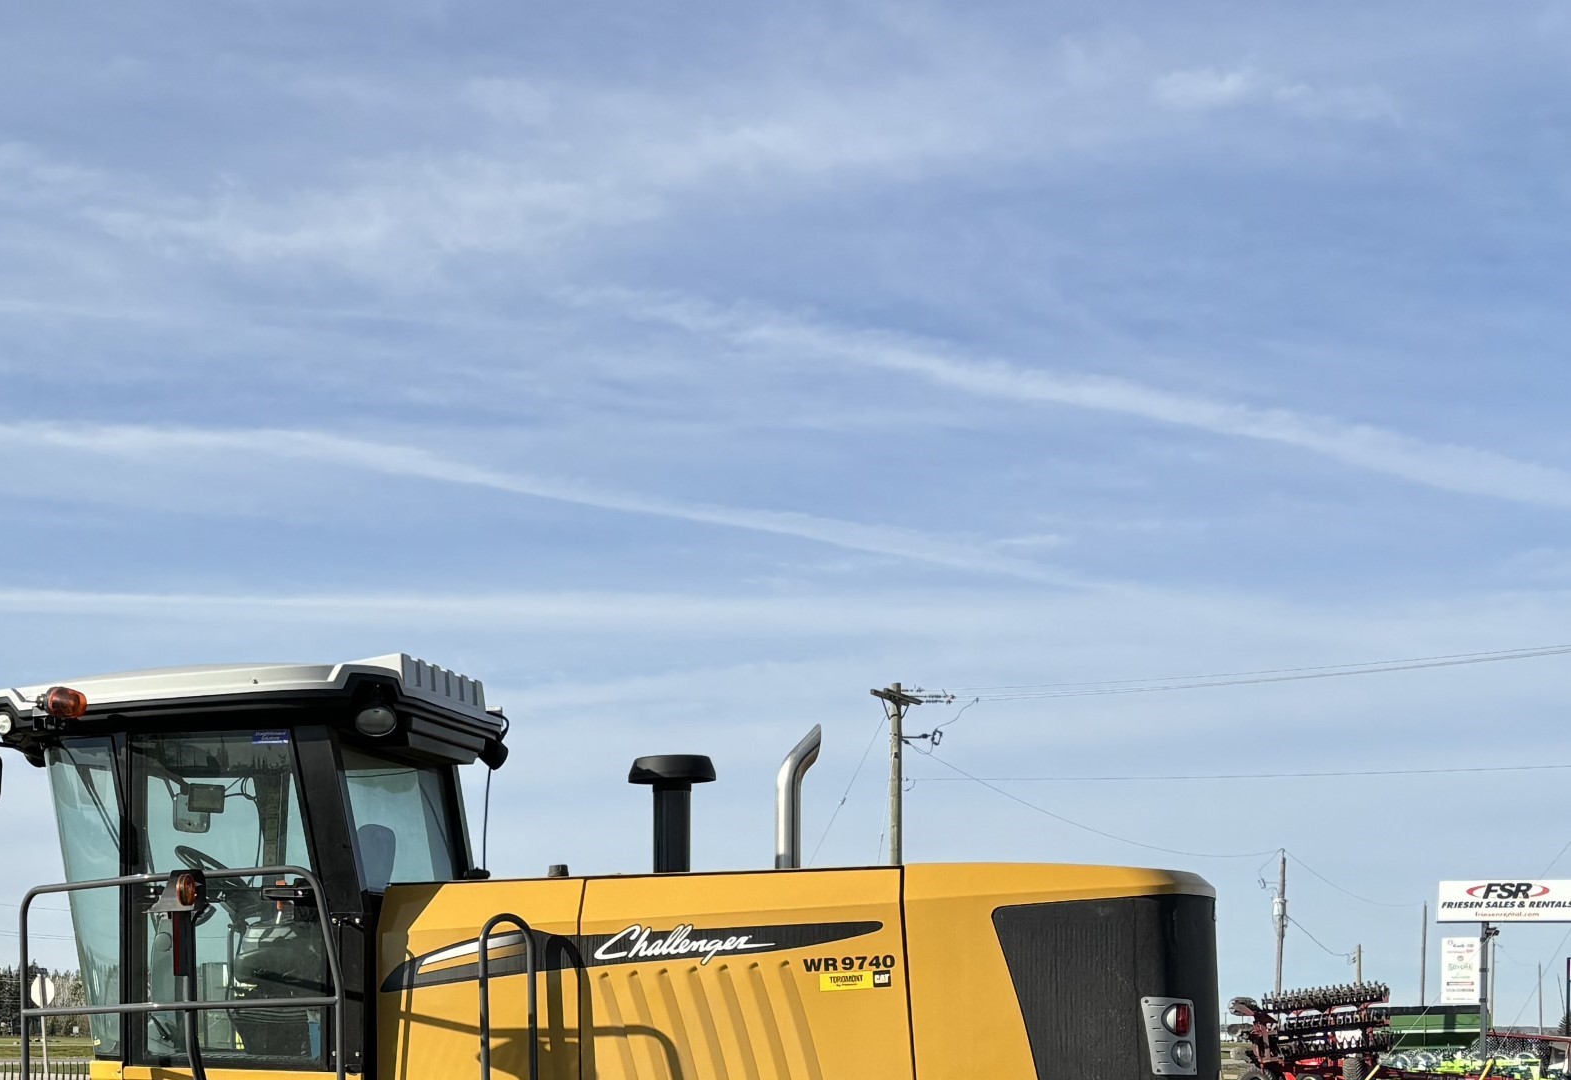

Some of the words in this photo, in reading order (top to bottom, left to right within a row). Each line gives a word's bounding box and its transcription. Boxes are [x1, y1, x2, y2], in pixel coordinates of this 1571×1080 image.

[1482, 883, 1533, 899] FSR
[1441, 901, 1484, 909] FRIESEN
[594, 924, 775, 965] Challenger
[874, 974, 890, 984] CAT
